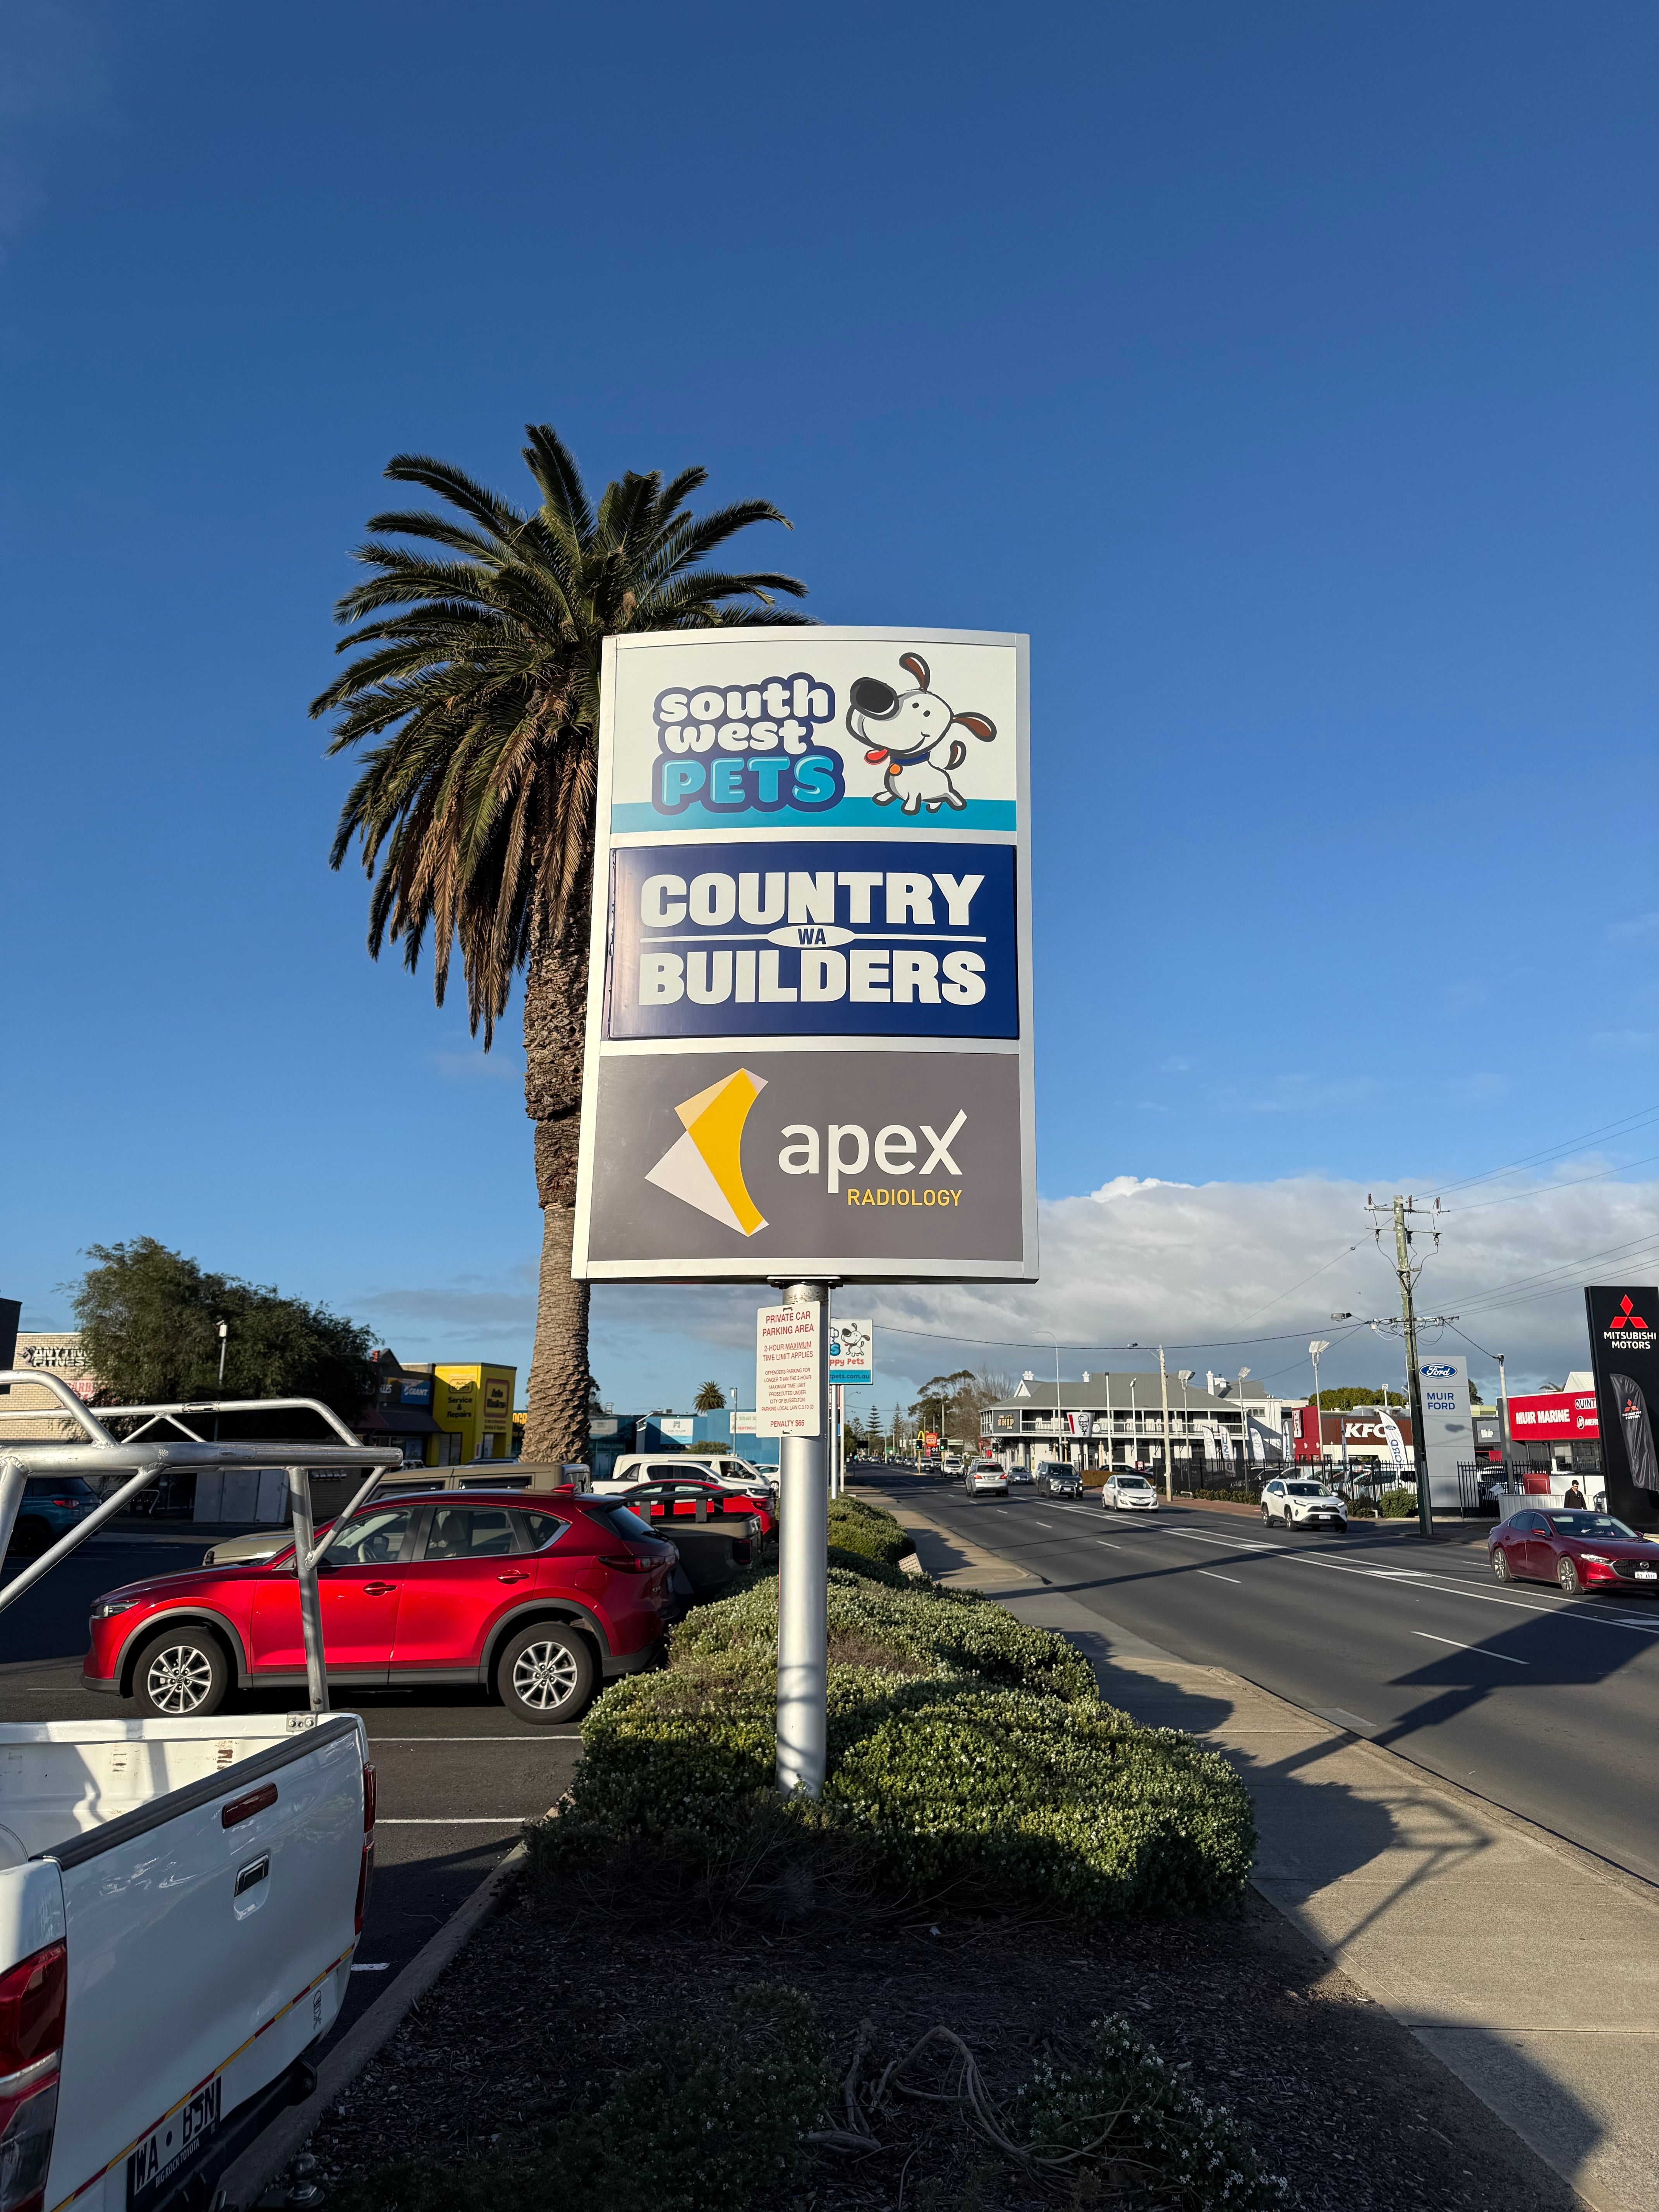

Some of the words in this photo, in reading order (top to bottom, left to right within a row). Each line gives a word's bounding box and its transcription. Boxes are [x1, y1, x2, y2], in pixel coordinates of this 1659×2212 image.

[660, 679, 828, 723] south
[665, 720, 808, 756] west
[661, 755, 839, 807] PETS
[641, 872, 986, 928] COUNTRY
[797, 928, 827, 945] WA
[638, 949, 987, 1006] BUILDERS
[778, 1108, 968, 1194] apex
[847, 1188, 963, 1207] RADIOLOGY
[766, 1313, 793, 1324] PRIVATE
[796, 1311, 811, 1320] CAR
[763, 1326, 793, 1336] PARKING
[795, 1324, 814, 1333] AREA
[1604, 1331, 1657, 1340] MITSUBISHI
[785, 1341, 812, 1350] MAXIMUM
[1611, 1341, 1651, 1349] MOTORS
[791, 1351, 813, 1359] APPLIES
[1426, 1365, 1450, 1376] Ford
[409, 1388, 428, 1396] GIANT
[1515, 1411, 1536, 1425] MUIR
[1537, 1409, 1570, 1424] MARINE
[1345, 1423, 1386, 1438] KFC
[135, 2135, 159, 2193] WA
[156, 2172, 165, 2188] BIG
[165, 2158, 180, 2175] ROCK
[180, 2138, 200, 2161] TOYOTA
